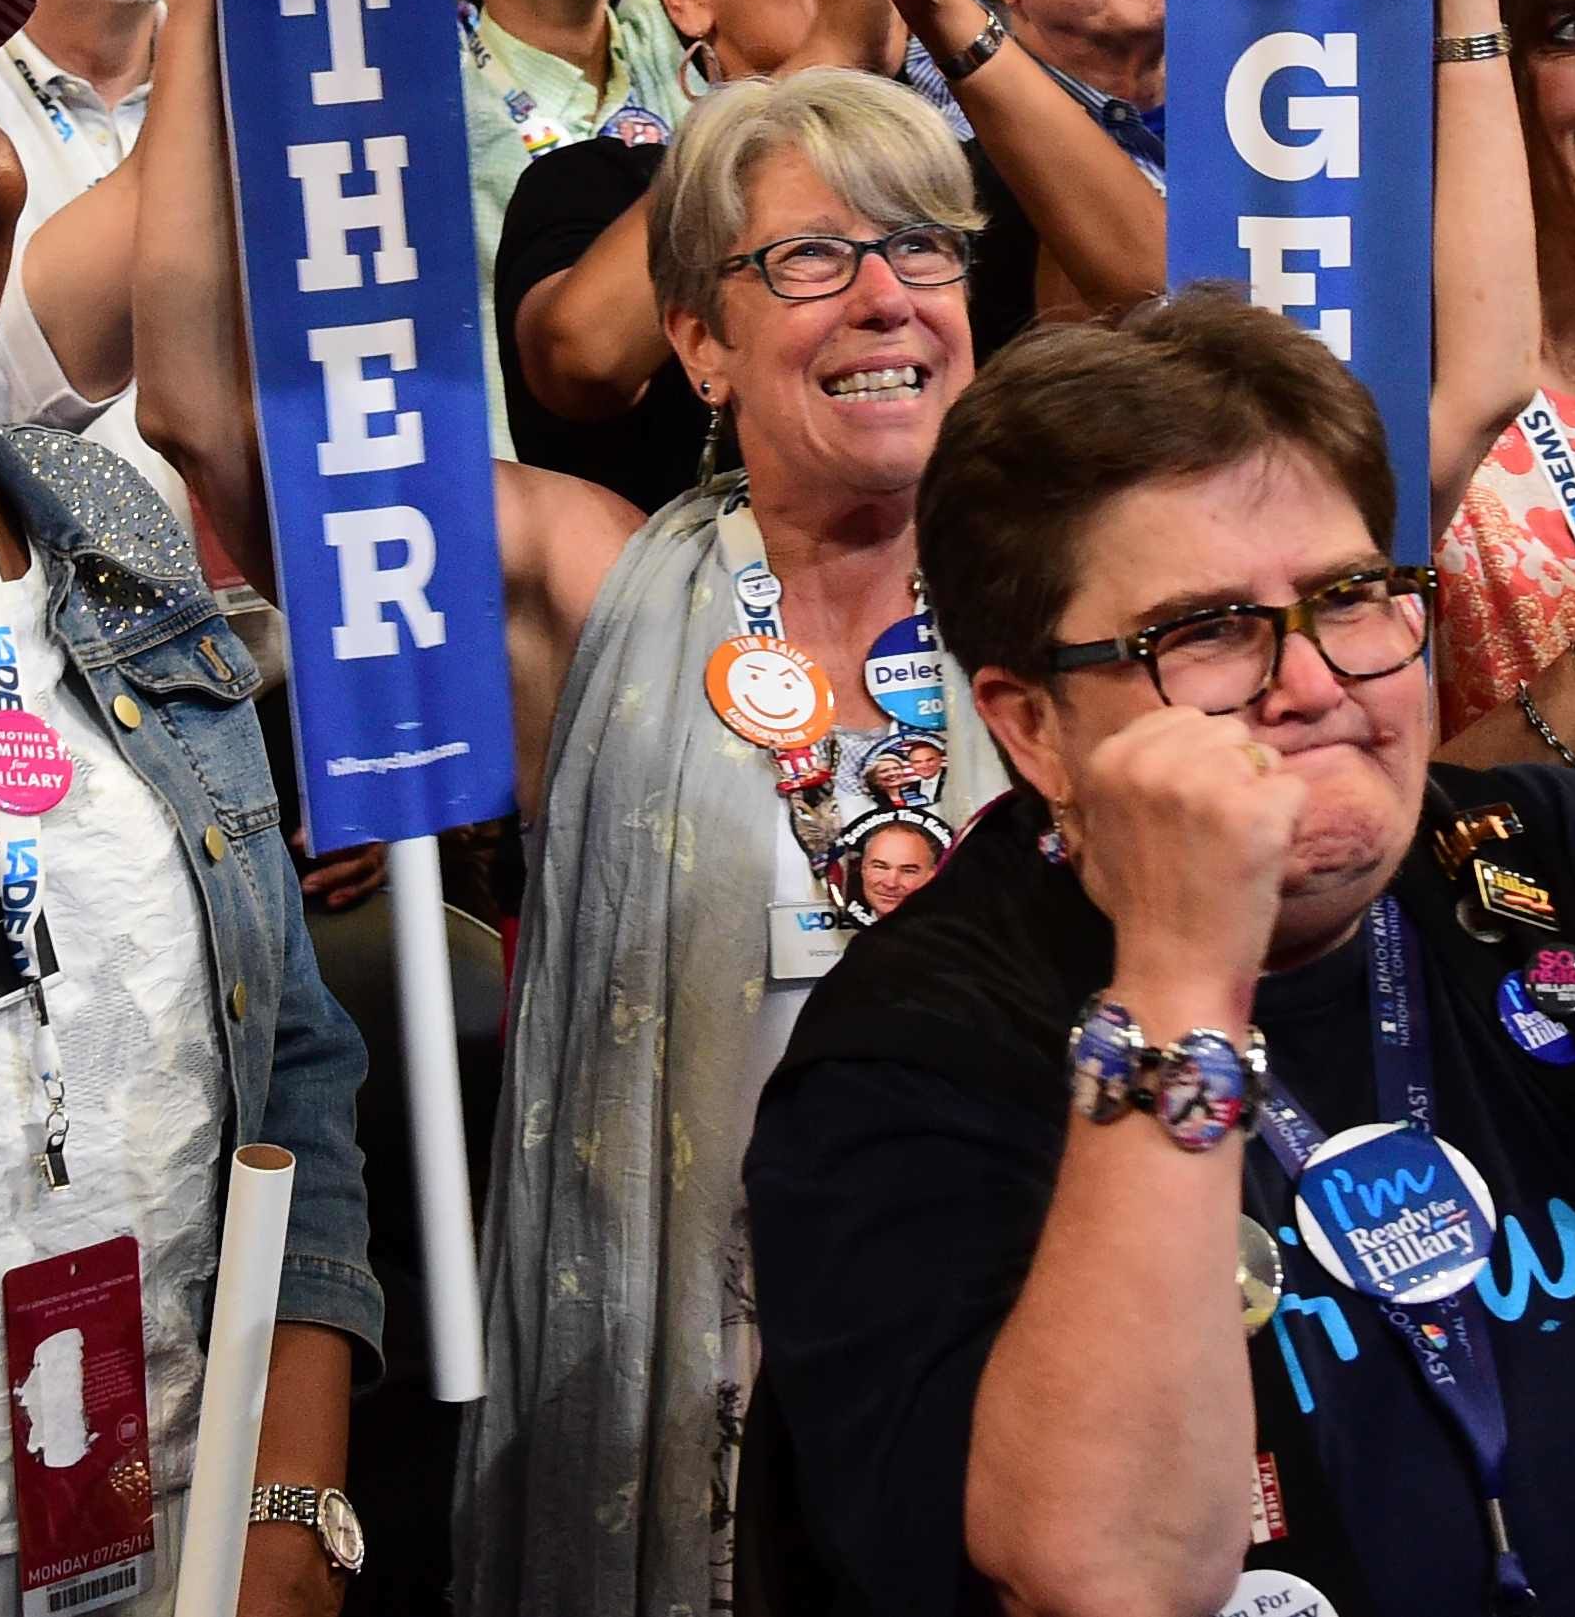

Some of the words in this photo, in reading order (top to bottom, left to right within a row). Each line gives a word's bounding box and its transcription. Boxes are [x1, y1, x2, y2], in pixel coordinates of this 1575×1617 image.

[732, 635, 763, 654] TIM
[768, 637, 817, 673] KAINE
[10, 758, 32, 772] for
[843, 811, 896, 846] Senator
[896, 808, 925, 824] Tim
[1537, 949, 1575, 969] SO
[1321, 1164, 1436, 1231] I'm
[1345, 1206, 1431, 1255] Ready
[1428, 1198, 1458, 1218] for
[1360, 1220, 1475, 1284] Hillary
[1379, 1303, 1457, 1386] OMCAST
[28, 1553, 91, 1585] MONDAY
[92, 1534, 153, 1567] 07/25/16
[1252, 1588, 1293, 1617] For
